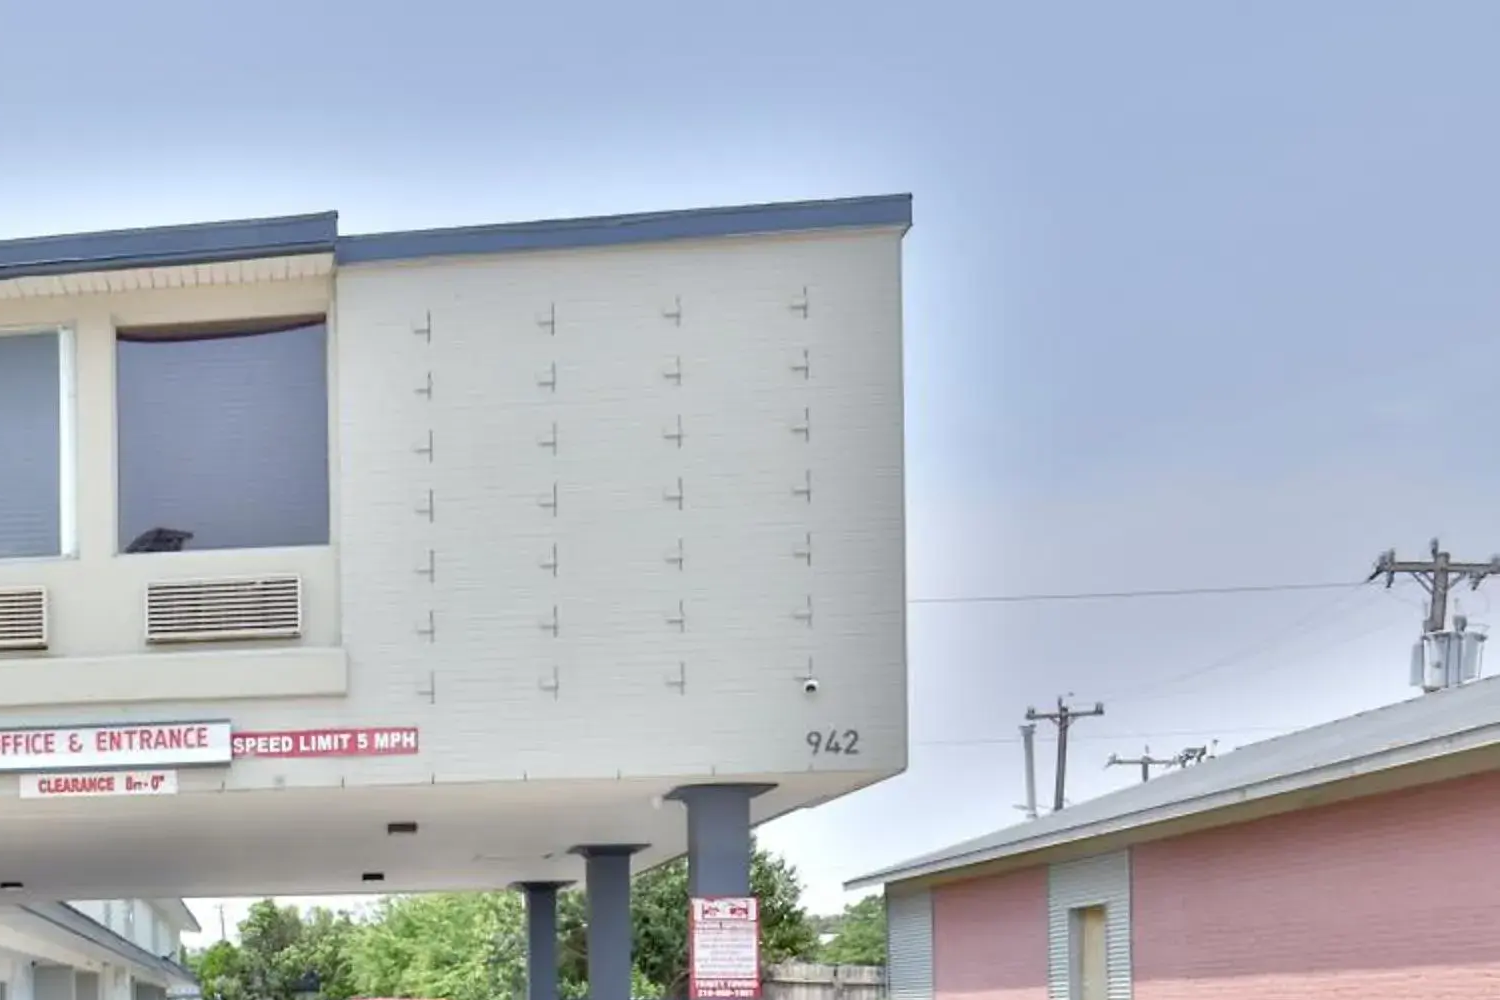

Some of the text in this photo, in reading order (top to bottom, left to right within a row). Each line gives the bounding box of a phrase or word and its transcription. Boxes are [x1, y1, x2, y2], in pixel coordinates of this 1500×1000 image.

[69, 733, 83, 753] &
[96, 727, 208, 750] ENTRANCE
[233, 731, 415, 753] SPEED LIMIT 5 MPH
[806, 729, 860, 755] 942
[38, 776, 115, 793] CLEARANCE
